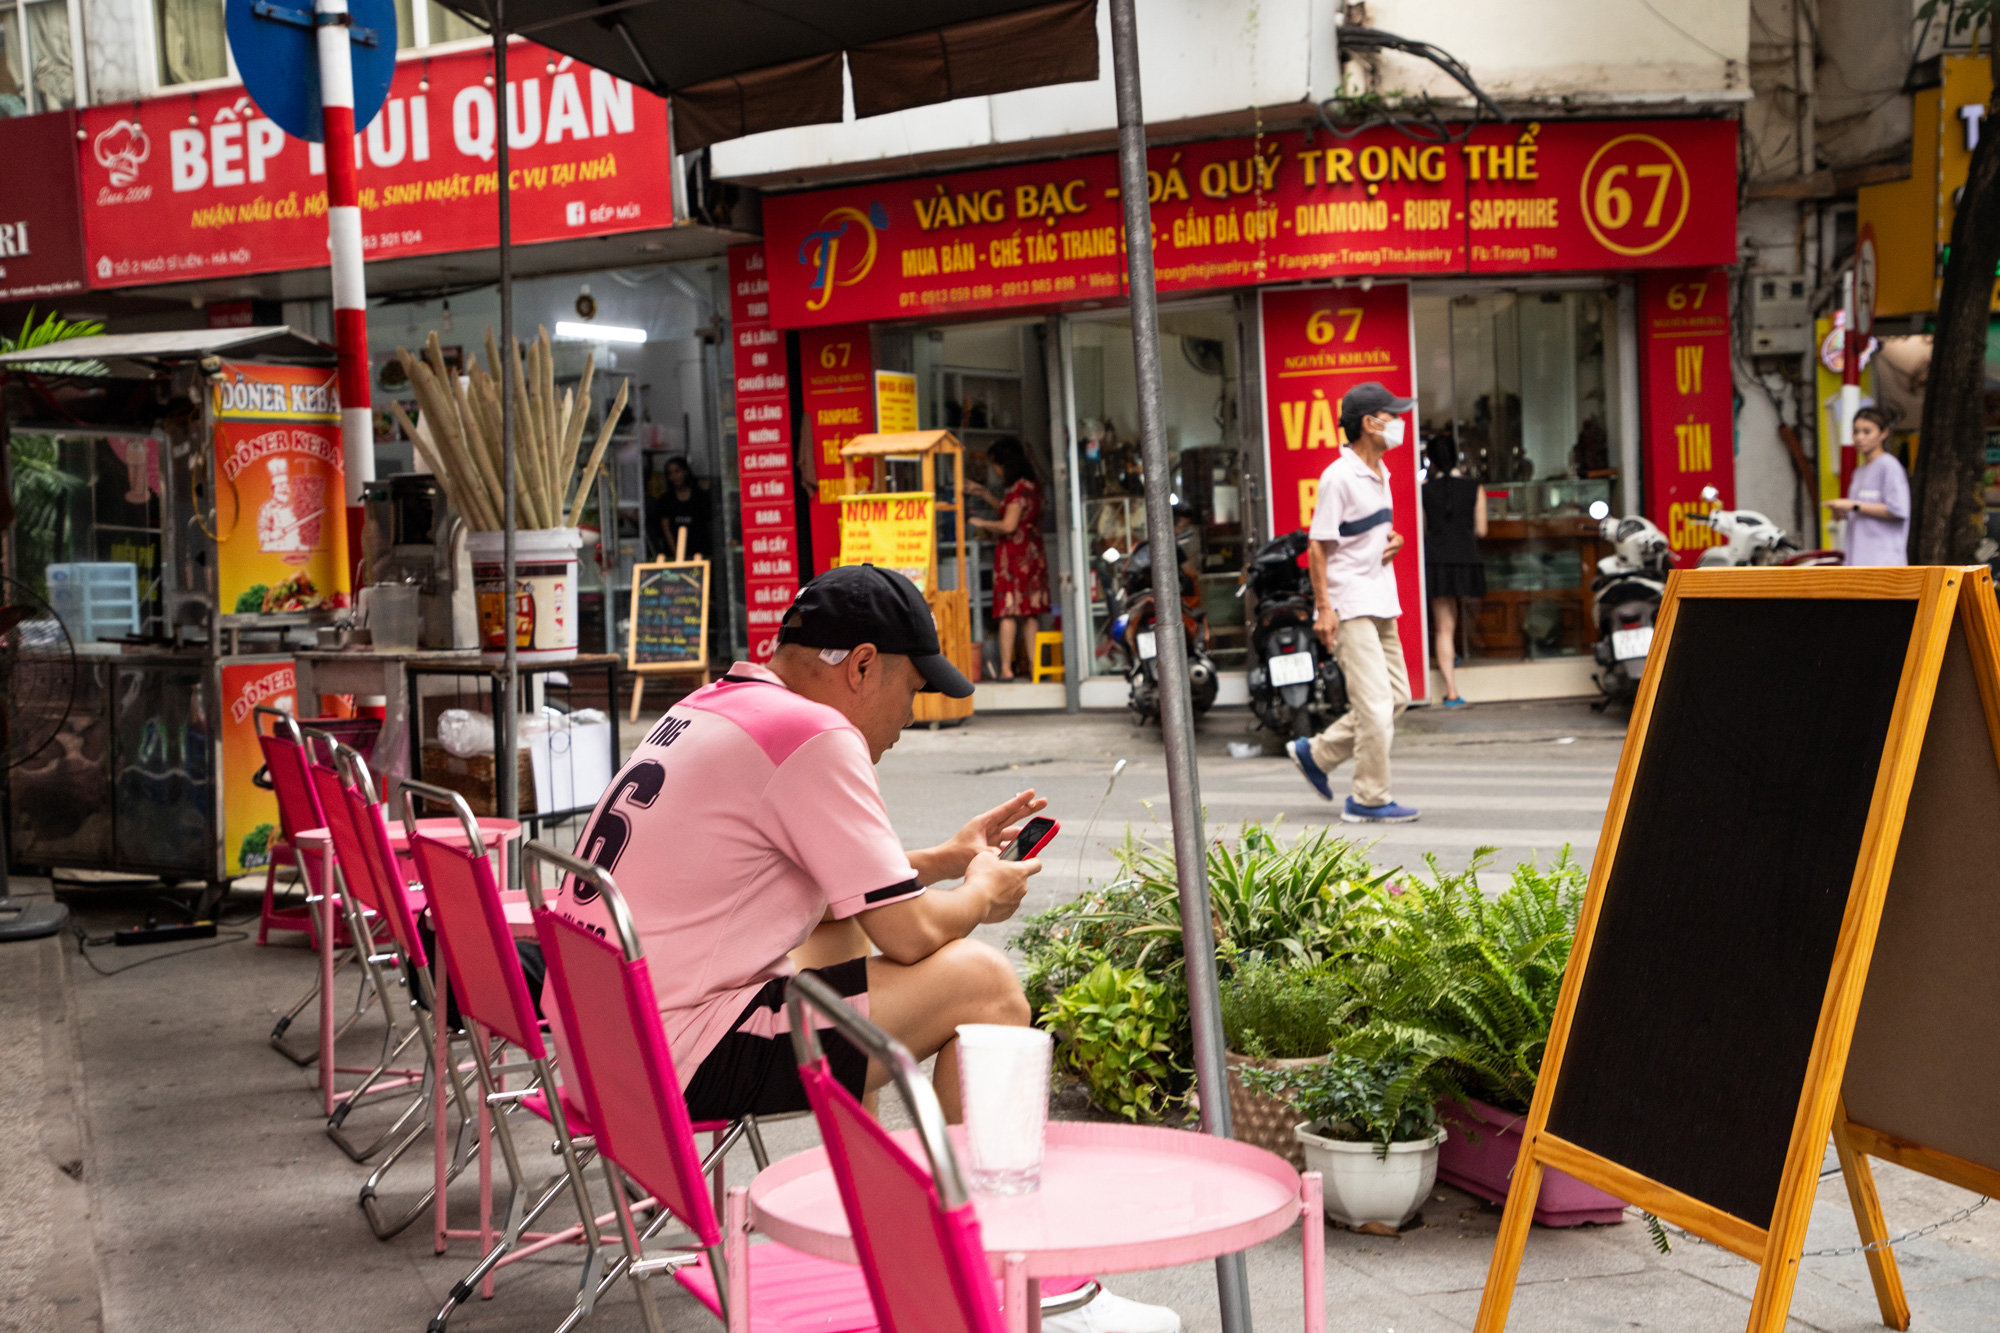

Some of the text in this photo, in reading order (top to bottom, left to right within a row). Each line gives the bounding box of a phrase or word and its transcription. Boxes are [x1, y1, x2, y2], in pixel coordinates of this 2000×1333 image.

[170, 97, 286, 193] BẾP
[453, 55, 634, 162] QUÁN
[191, 203, 236, 229] NHẬN
[382, 181, 422, 206] SINH
[473, 168, 521, 196] PHC
[523, 166, 548, 191] VỤ
[550, 163, 576, 188] TẠI
[578, 153, 617, 181] NHÀ
[914, 184, 1004, 230] VÀNG
[1015, 180, 1087, 227] BẠC
[1200, 142, 1281, 199] QUÝ
[1297, 145, 1447, 196] TRỌNG
[1463, 121, 1541, 181] THỂ
[1594, 164, 1673, 230] 67
[1243, 202, 1279, 244] QUÝ
[1295, 200, 1389, 237] DIAMOND
[1404, 199, 1451, 231] RUBY
[1469, 197, 1559, 231] SAPPHIRE
[901, 247, 938, 278] MUA
[941, 239, 976, 273] BÁN
[989, 228, 1023, 269] CHẾ
[1025, 226, 1057, 264] TÁC
[1061, 226, 1117, 261] TRANG
[1666, 282, 1708, 311] 67
[1306, 307, 1364, 345] 67
[820, 342, 851, 369] 67
[1675, 345, 1704, 395] UY
[221, 373, 341, 413] DÖNER KEBA
[223, 430, 344, 481] DÖNER KEBA
[1675, 413, 1712, 473] TÍN
[894, 498, 928, 521] 20K
[231, 668, 297, 724] DÖNER
[646, 716, 692, 747] TNG
[572, 758, 667, 906] 6
